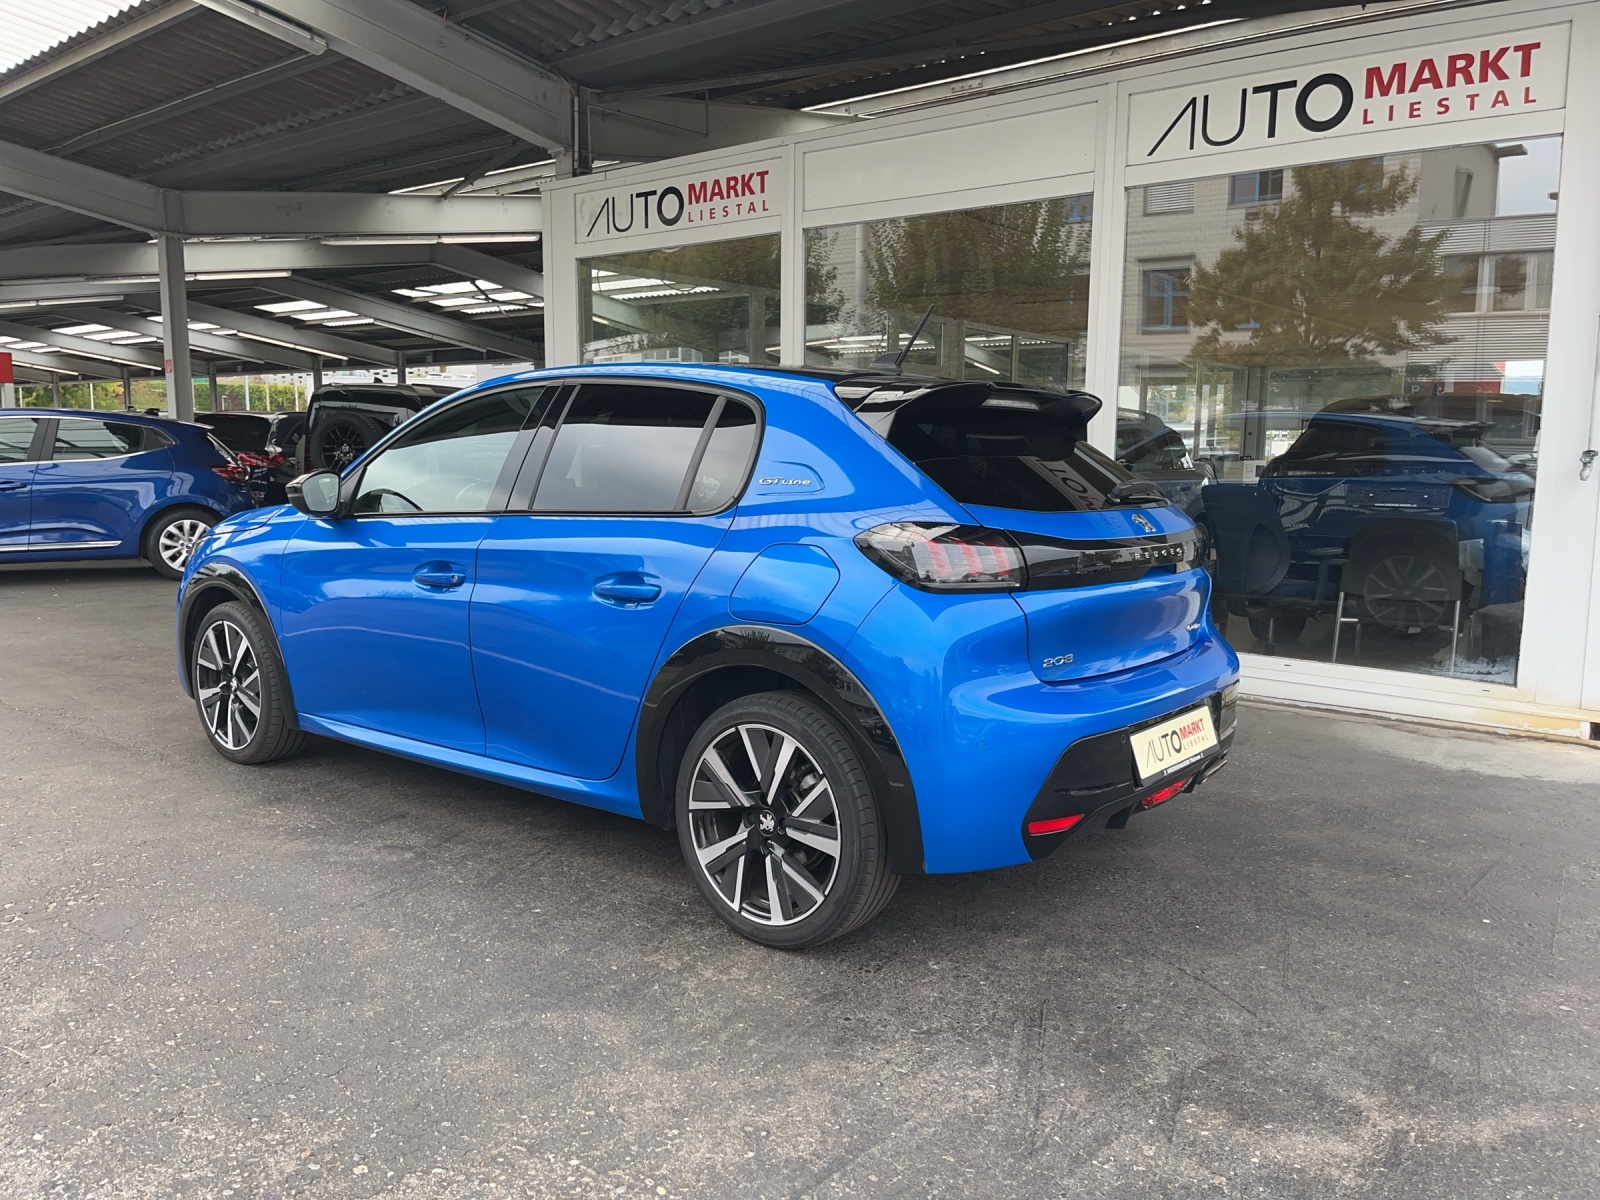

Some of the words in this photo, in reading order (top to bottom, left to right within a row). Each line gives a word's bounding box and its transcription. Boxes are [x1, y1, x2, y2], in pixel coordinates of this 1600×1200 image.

[1147, 73, 1354, 157] AUTO
[1364, 42, 1541, 99] MARKT
[1363, 86, 1538, 125] LIESTAL
[586, 186, 685, 237] AUTO
[688, 170, 769, 206] MARKT
[688, 199, 769, 223] LIESTAL
[1042, 653, 1074, 669] 208
[1146, 729, 1183, 768] AUTO
[1178, 718, 1206, 741] MARKT
[1183, 734, 1209, 750] LIESTAL
